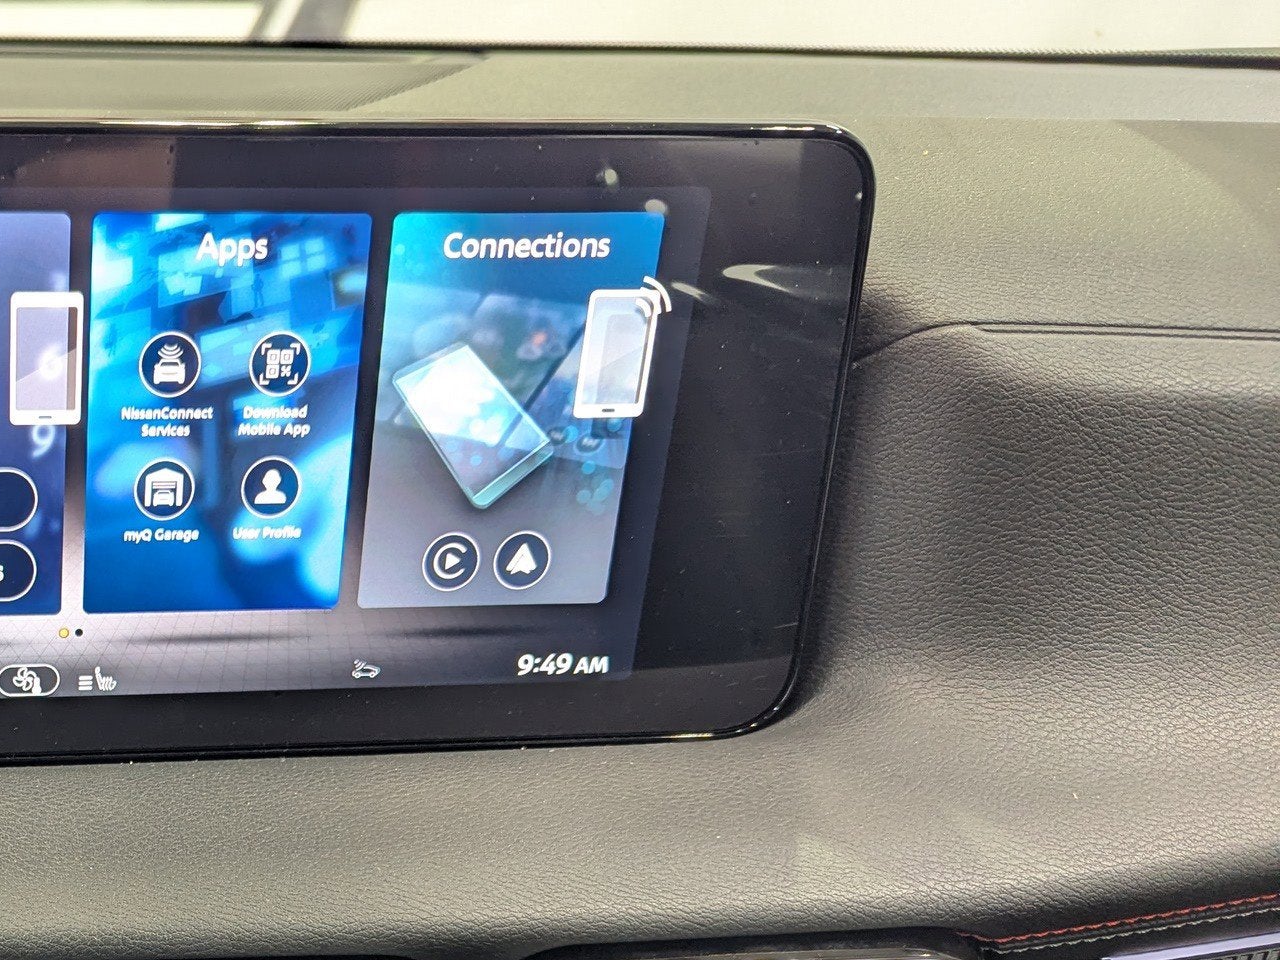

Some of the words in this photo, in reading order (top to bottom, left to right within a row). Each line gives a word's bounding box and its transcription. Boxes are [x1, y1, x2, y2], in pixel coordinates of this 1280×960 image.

[197, 234, 268, 263] Apps
[443, 231, 611, 259] Connections
[121, 406, 213, 420] NissanConnect
[243, 404, 308, 419] Download
[141, 423, 190, 437] Services
[238, 424, 281, 436] Mobile
[284, 423, 311, 438] App
[124, 529, 151, 544] myQ
[154, 528, 199, 543] Garage
[232, 527, 259, 540] User
[262, 526, 302, 540] Profile
[517, 653, 573, 676] 9:49
[573, 655, 610, 674] AM
